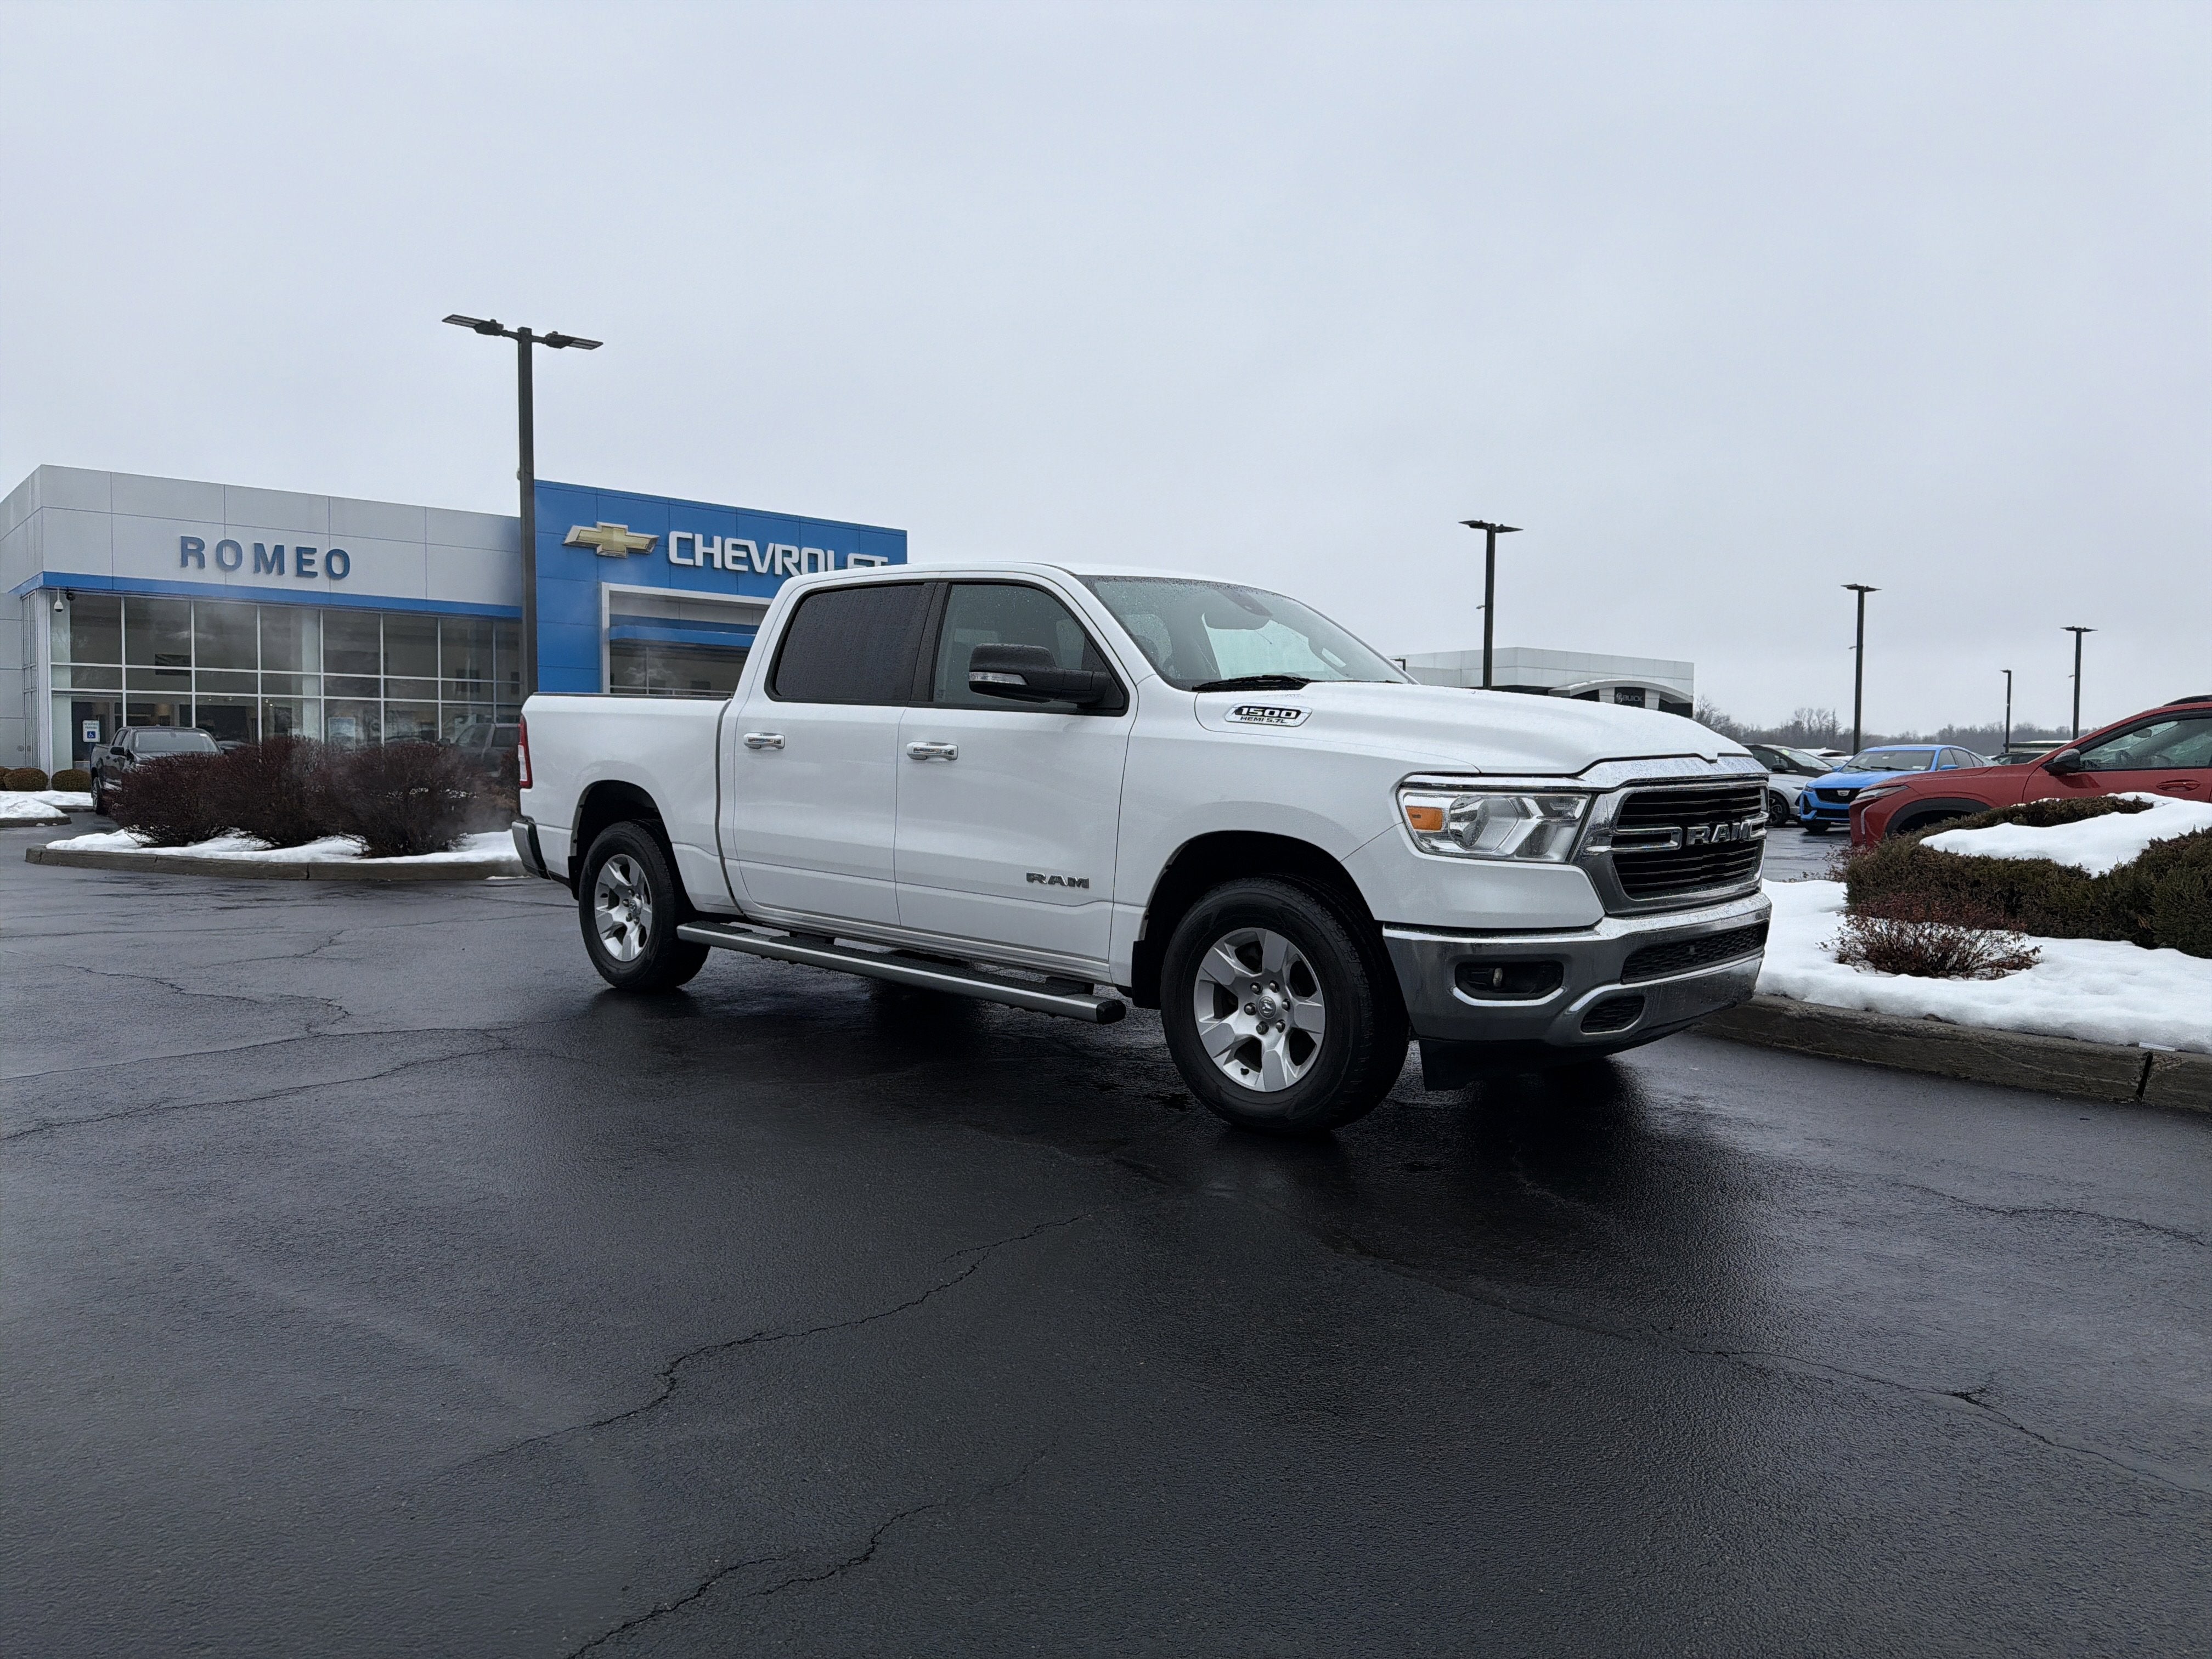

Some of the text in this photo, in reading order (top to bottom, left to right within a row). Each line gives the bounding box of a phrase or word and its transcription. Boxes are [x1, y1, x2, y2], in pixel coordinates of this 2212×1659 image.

[180, 535, 351, 580] ROMEO
[669, 531, 888, 576] CHEVRO
[1241, 707, 1297, 718] 1500
[1686, 821, 1750, 846] RAM
[1026, 872, 1090, 889] RAM
